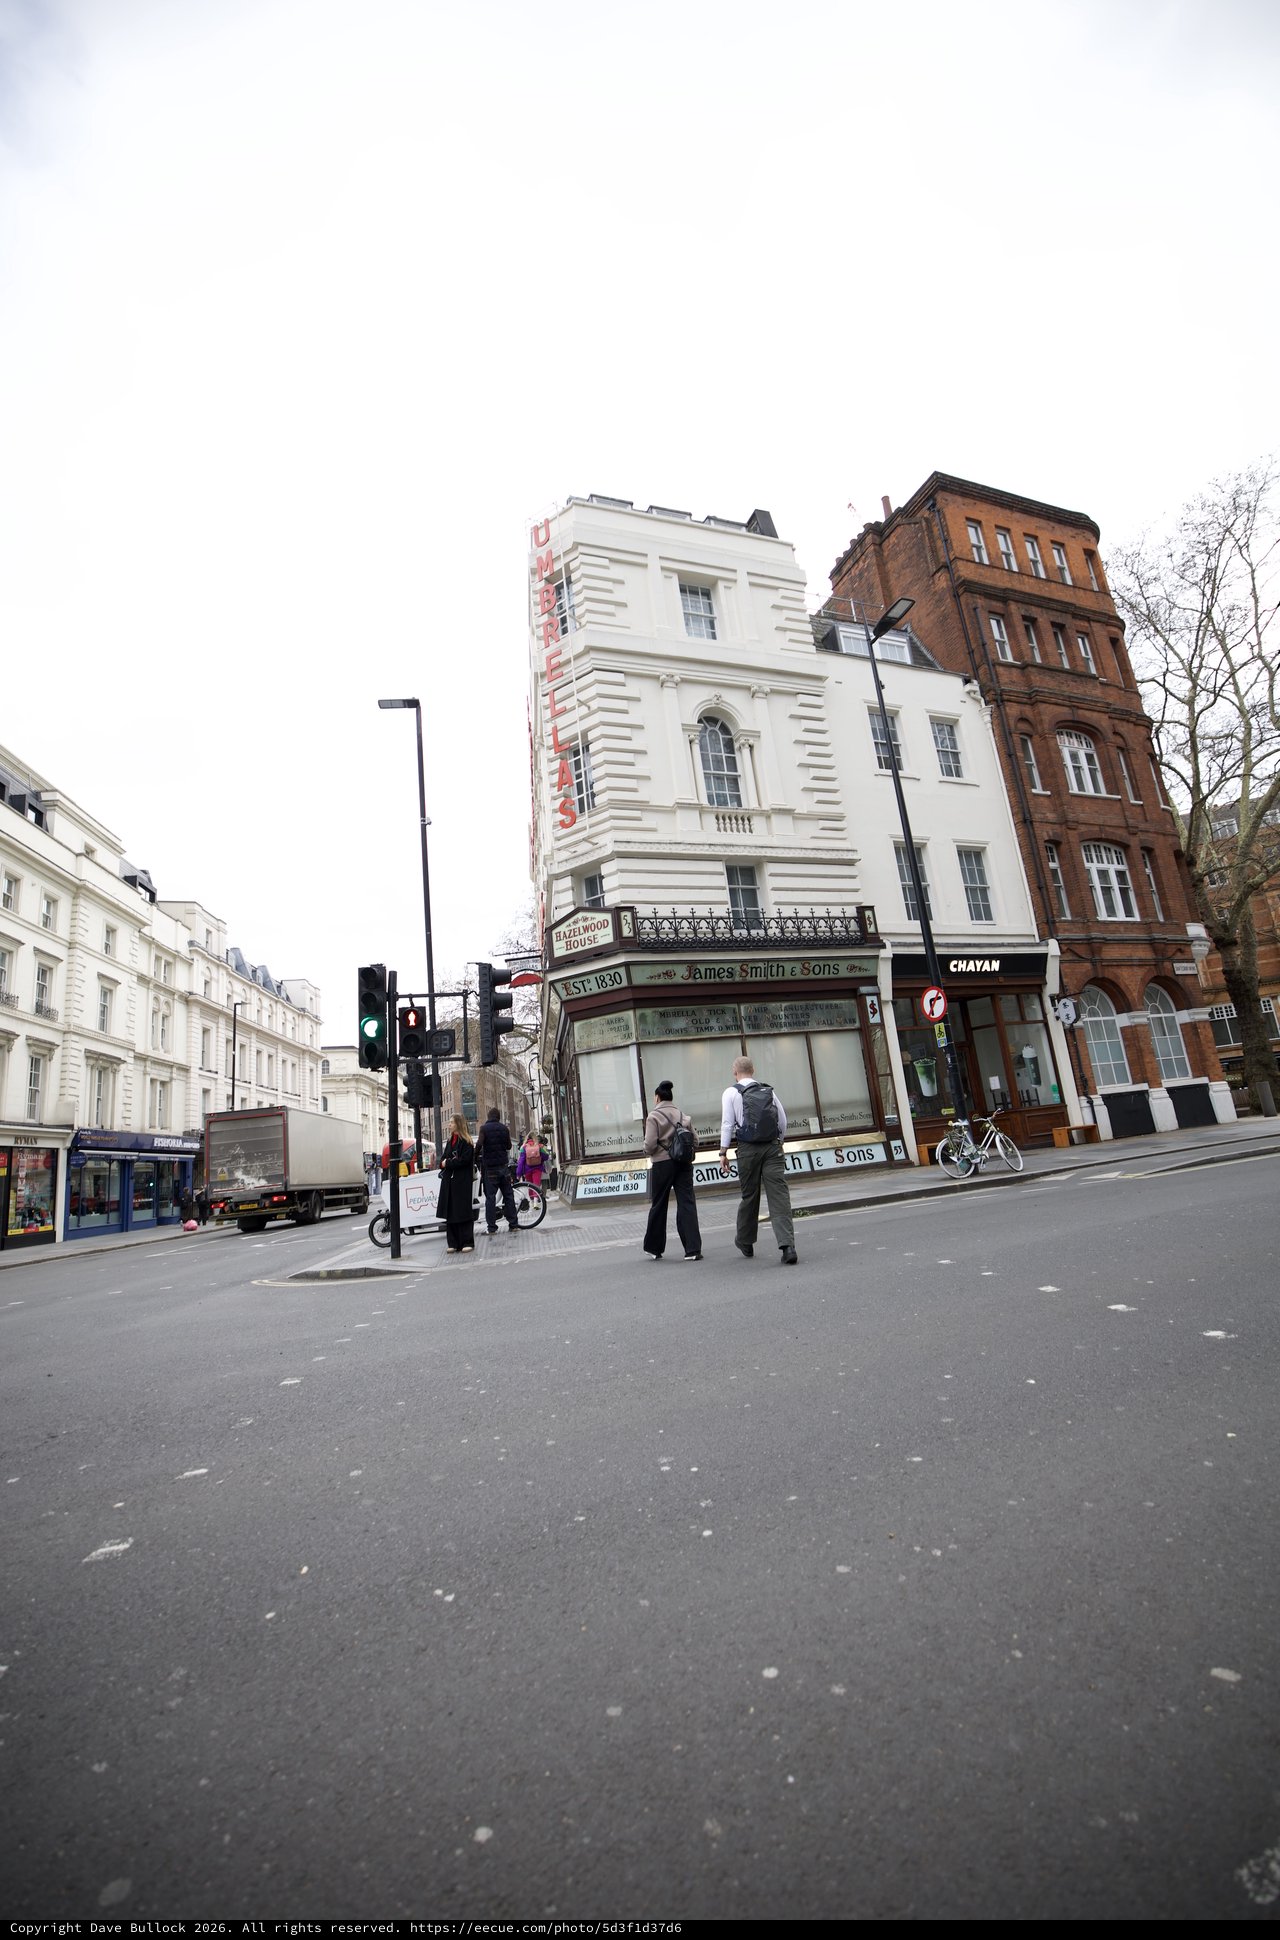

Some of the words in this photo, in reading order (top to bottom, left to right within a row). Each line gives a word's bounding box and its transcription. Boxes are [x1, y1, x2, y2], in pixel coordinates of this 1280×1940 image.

[533, 518, 577, 829] UMBRELLAS
[555, 918, 609, 943] HAZELWOOD
[565, 934, 599, 951] HOUSE
[681, 963, 734, 980] James
[739, 960, 785, 979] Smith
[801, 961, 840, 976] Sons
[950, 960, 1000, 972] CHAYAN
[596, 971, 623, 988] 1830
[655, 1010, 697, 1019] MBRELLA
[704, 1008, 726, 1016] TICK
[14, 1136, 38, 1145] RYMAN
[585, 1139, 606, 1148] James
[17, 1152, 44, 1160] Ryman
[696, 1163, 739, 1183] ames
[834, 1147, 875, 1164] Sons
[579, 1176, 602, 1185] James
[603, 1173, 623, 1183] Smith
[628, 1172, 647, 1181] Sons
[584, 1184, 621, 1195] Established
[623, 1183, 639, 1192] 1830
